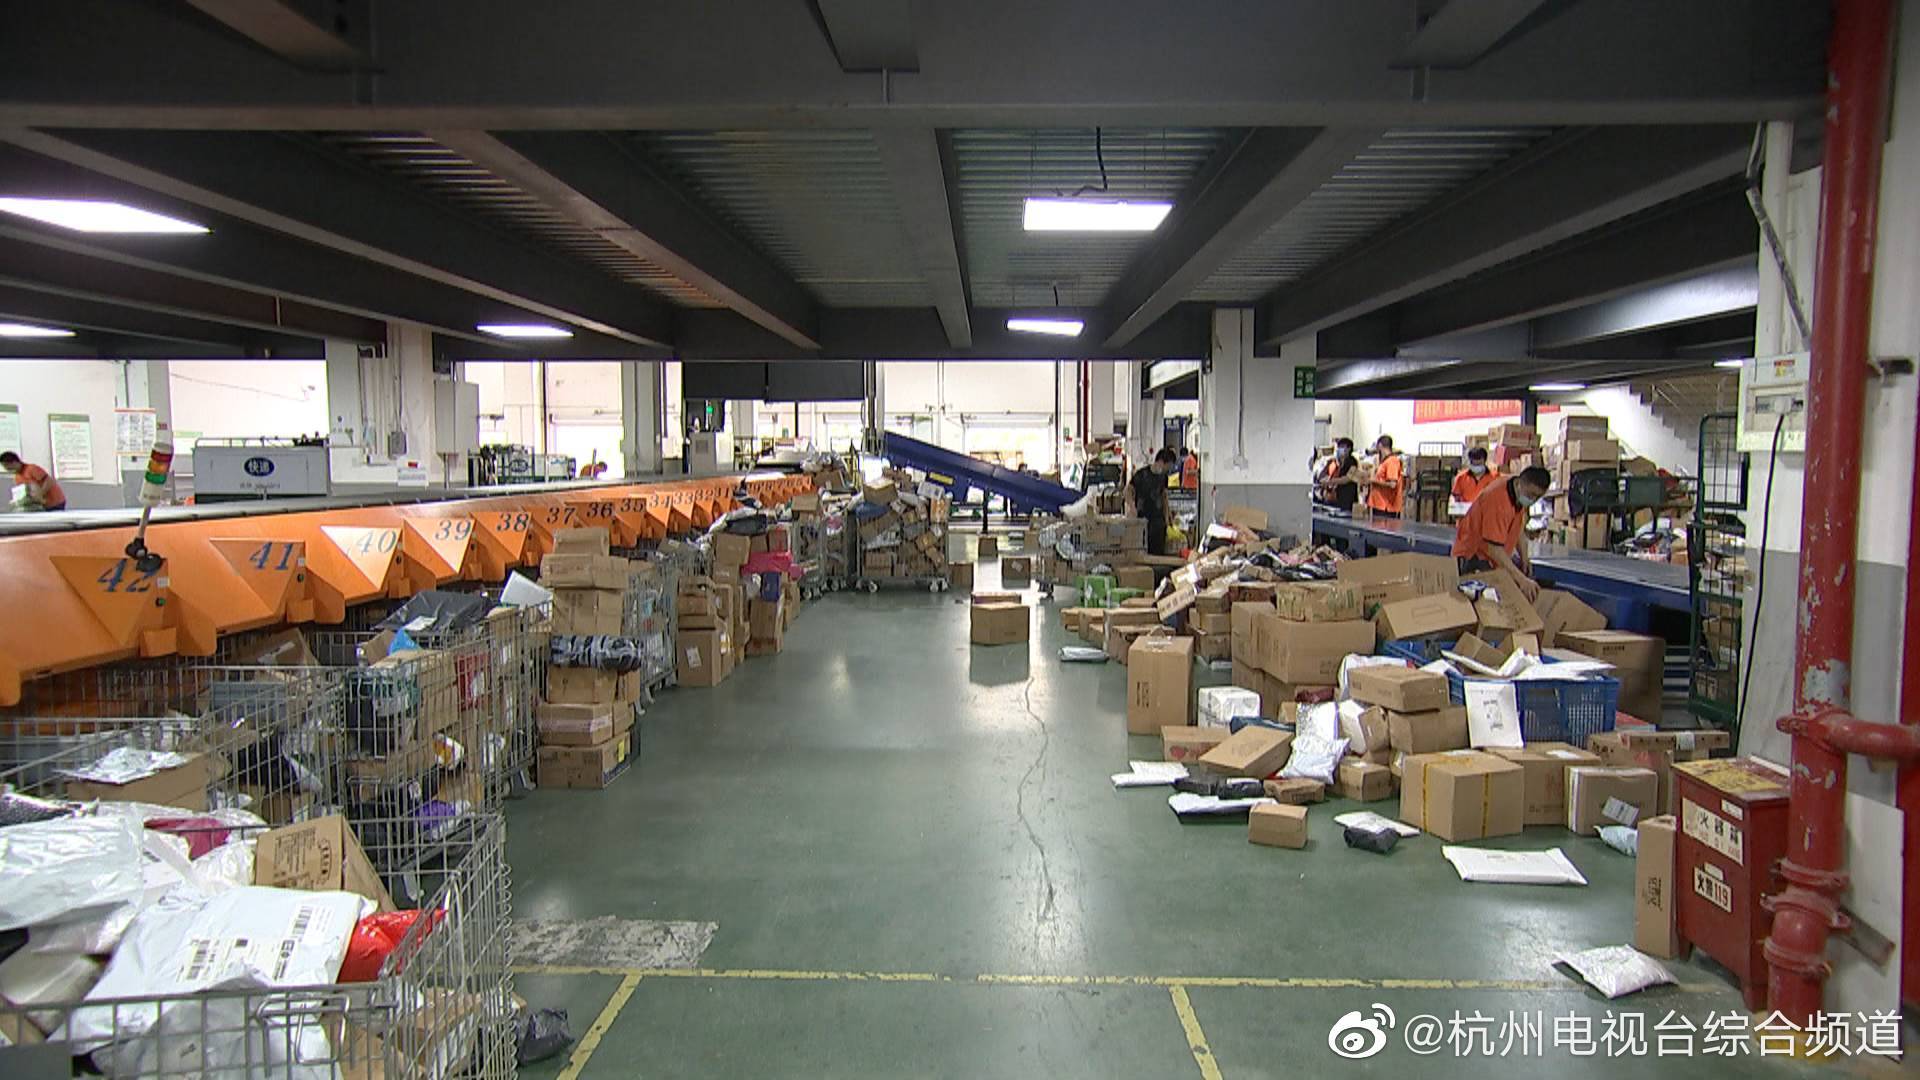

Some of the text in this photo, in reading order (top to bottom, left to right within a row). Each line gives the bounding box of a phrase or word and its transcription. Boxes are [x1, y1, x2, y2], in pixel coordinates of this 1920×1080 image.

[649, 494, 670, 508] 34
[673, 491, 693, 504] 33
[695, 488, 713, 500] 32
[587, 502, 613, 518] 36
[620, 498, 644, 512] 35
[496, 512, 529, 532] 38
[547, 507, 575, 524] 37
[435, 519, 472, 541] 39
[356, 529, 397, 554] 40
[249, 541, 294, 571] 41
[1697, 872, 1729, 906] 火警119
